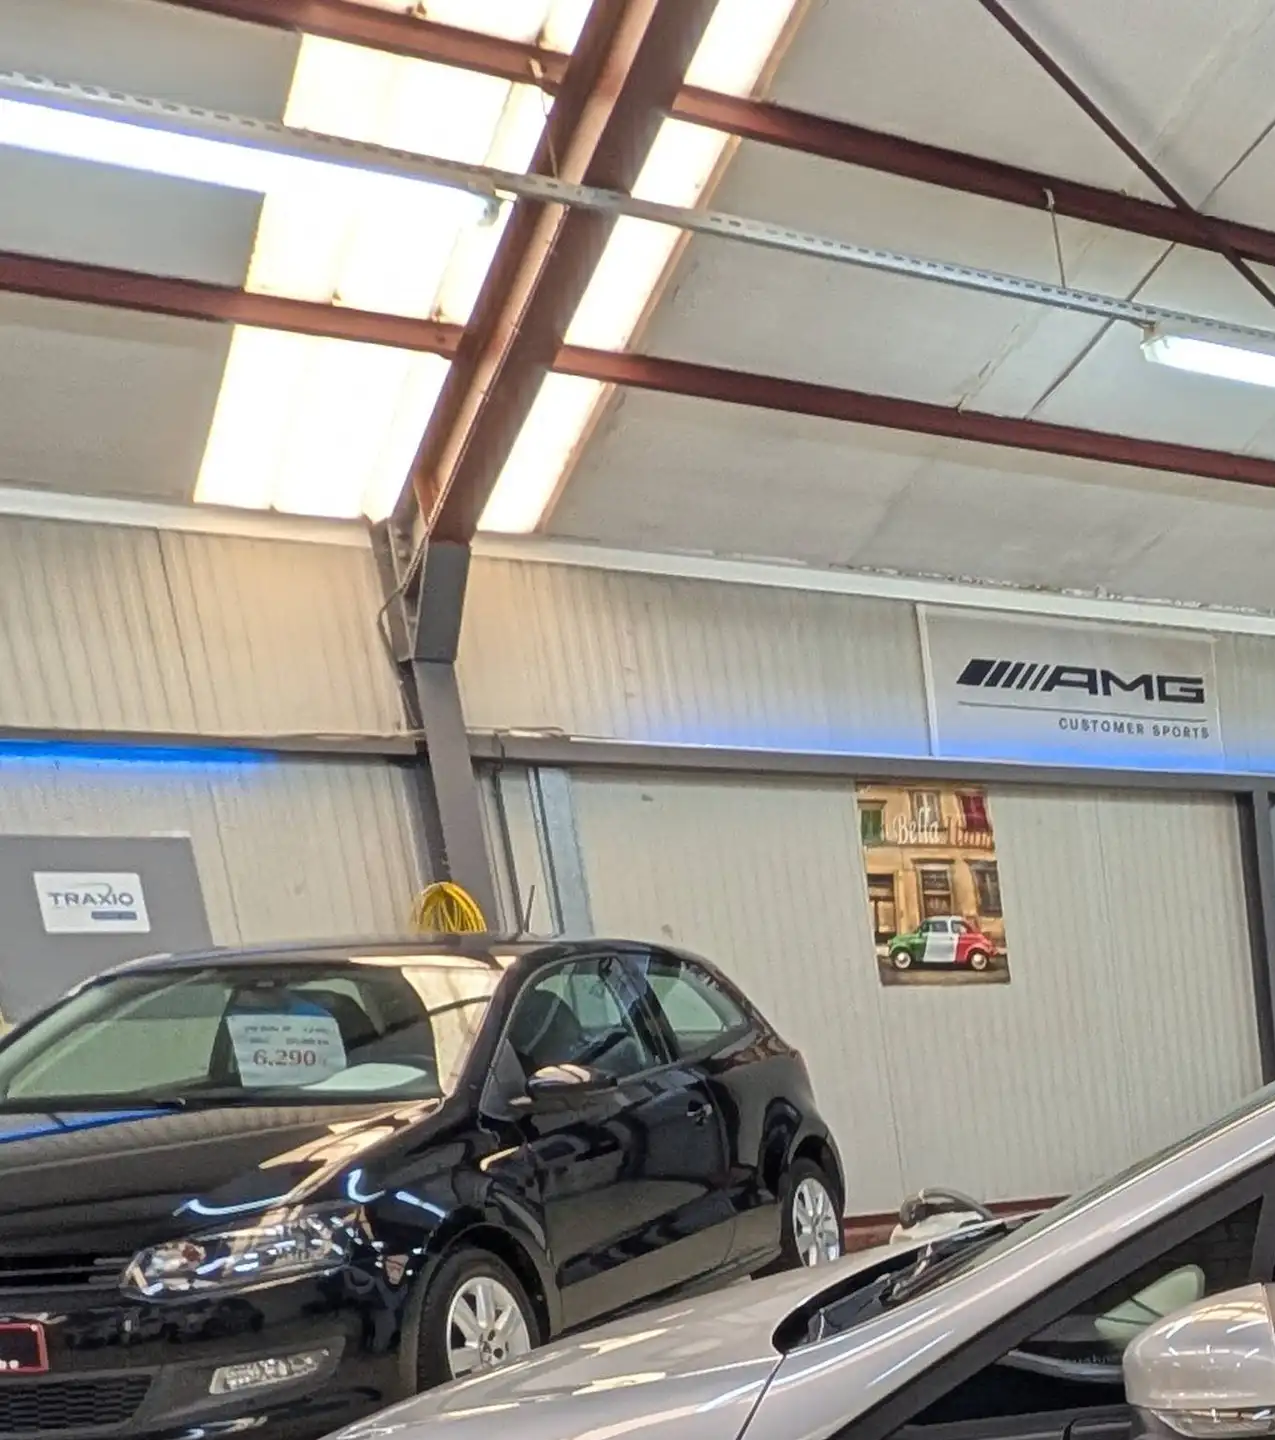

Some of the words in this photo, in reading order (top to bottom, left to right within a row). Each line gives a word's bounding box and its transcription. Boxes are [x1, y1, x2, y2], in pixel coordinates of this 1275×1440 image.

[1041, 664, 1205, 704] AMG
[1058, 716, 1145, 736] CUSTOMER
[1152, 724, 1210, 740] SPORTS
[46, 890, 135, 907] TRAXIO
